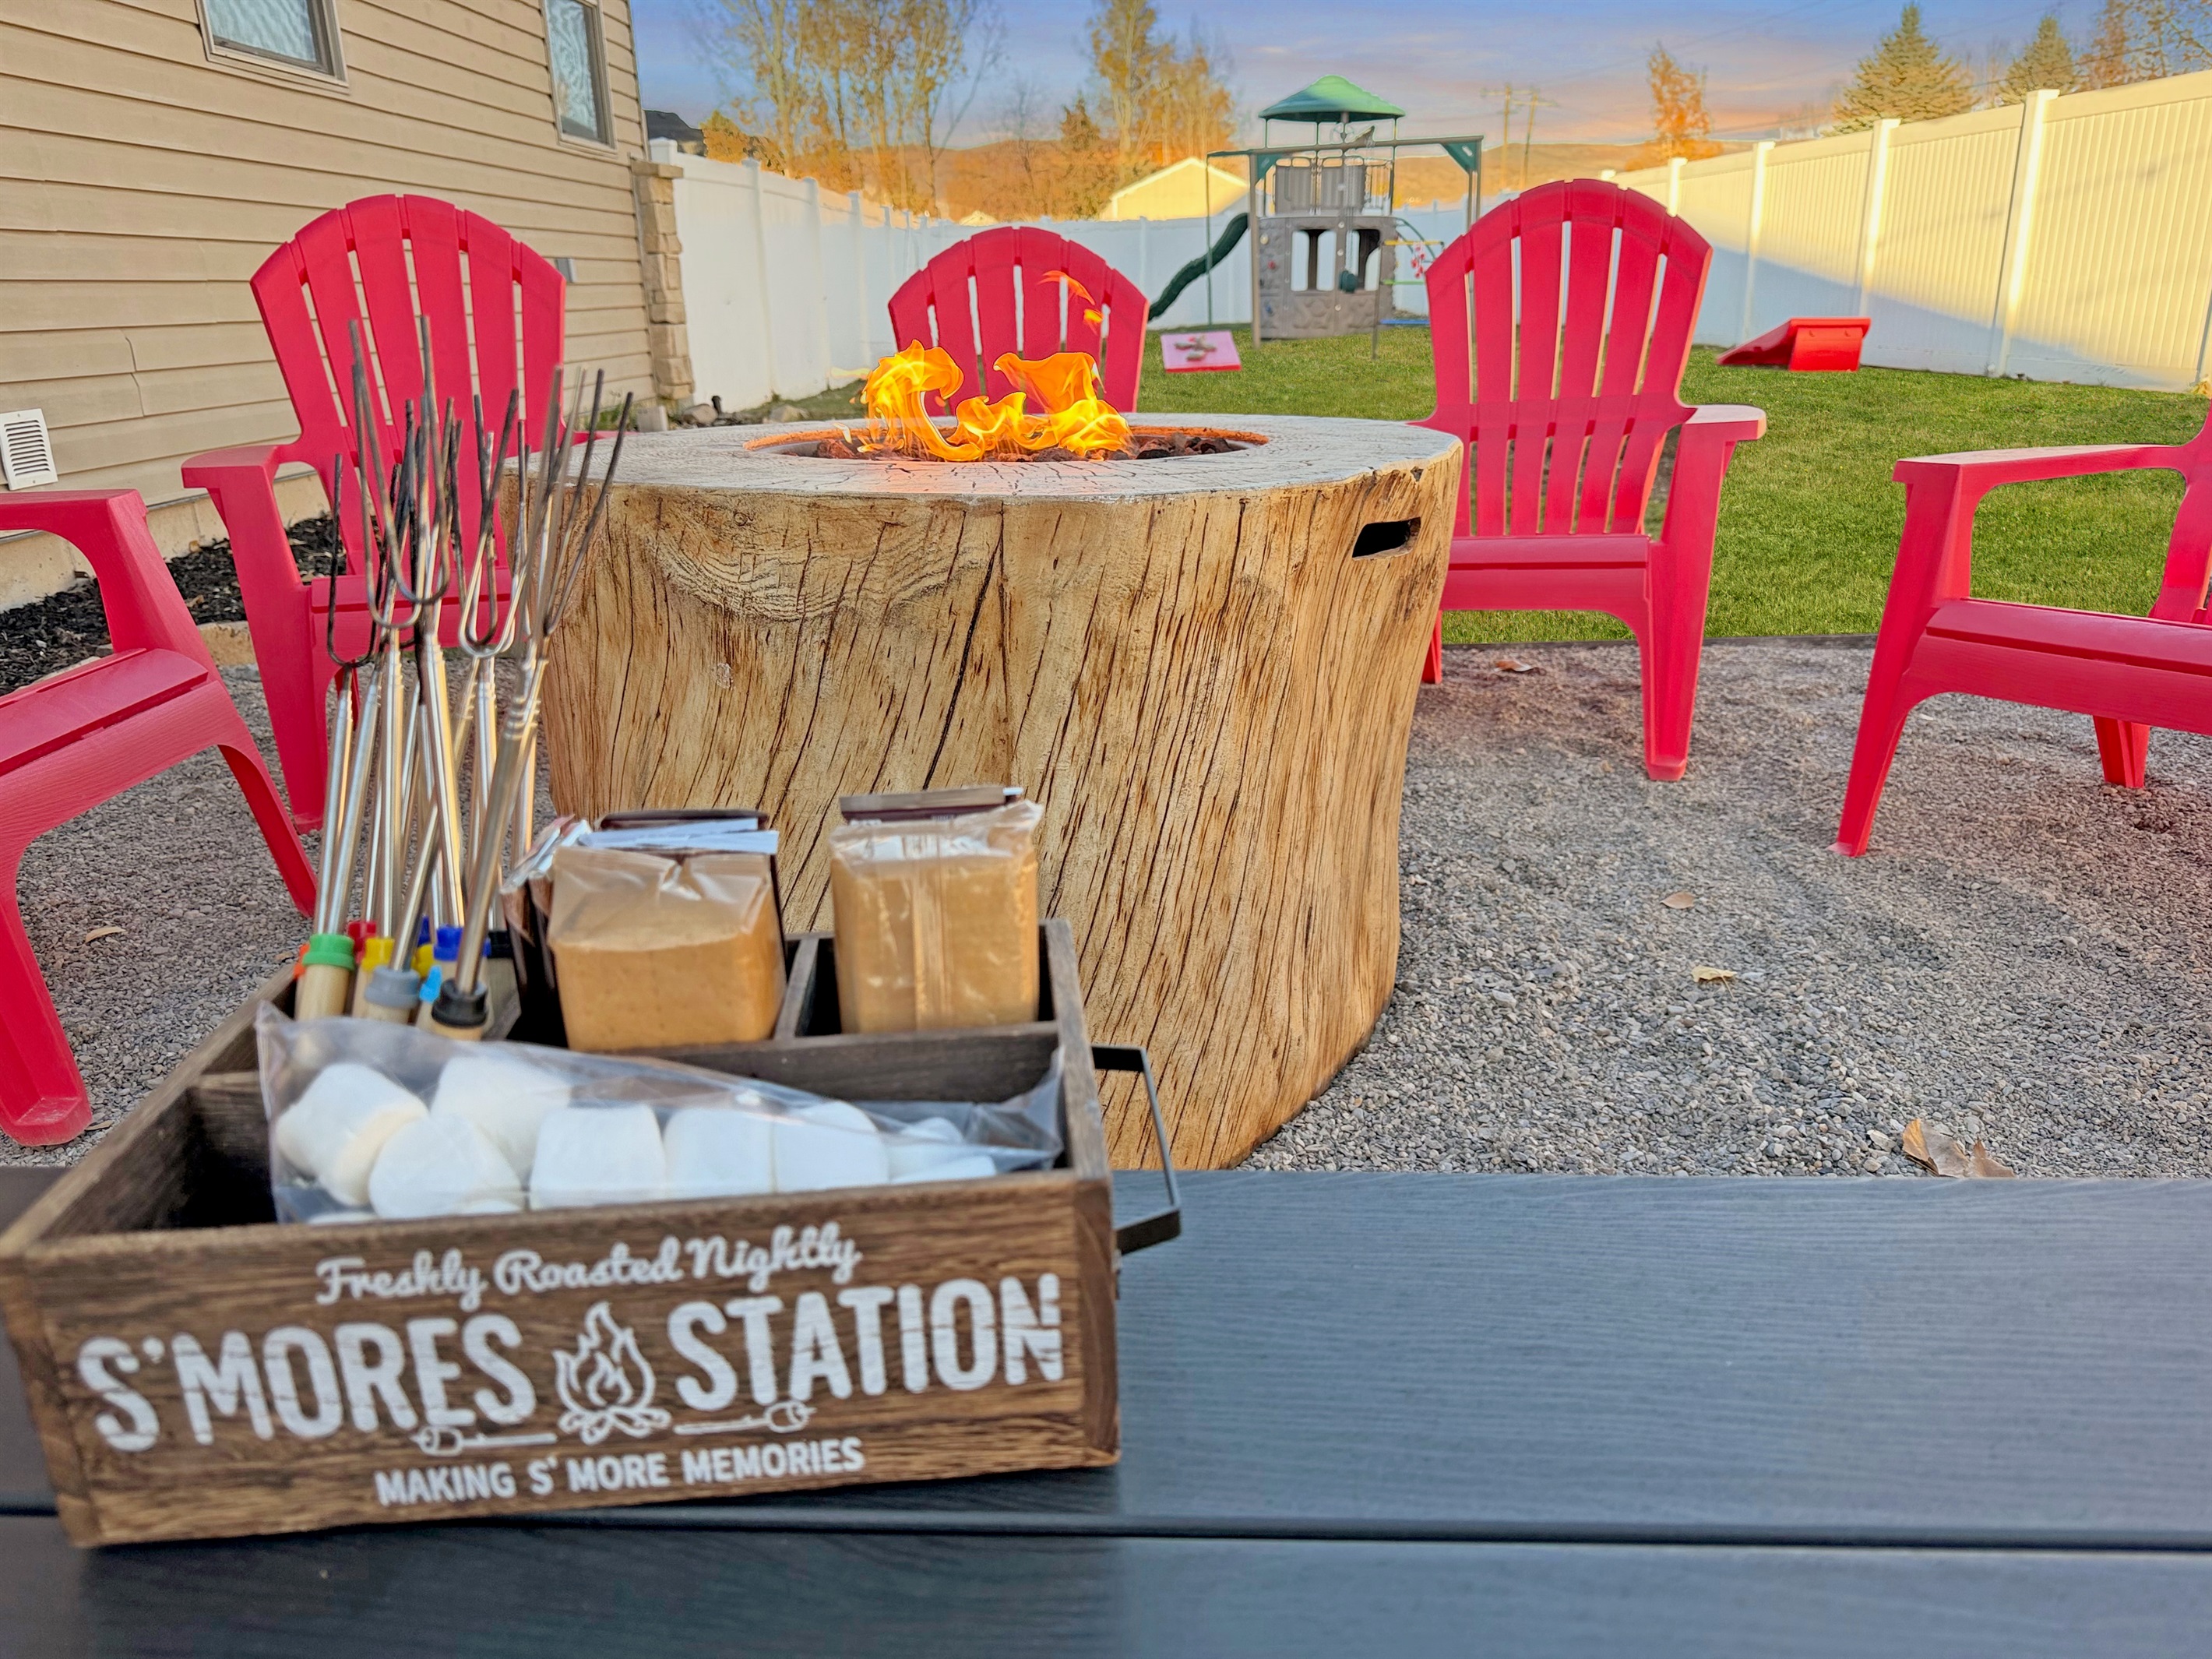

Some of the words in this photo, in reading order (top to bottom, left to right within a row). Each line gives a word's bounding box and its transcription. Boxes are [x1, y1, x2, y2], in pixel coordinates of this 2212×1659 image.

[315, 1248, 488, 1312] Freshly
[493, 1235, 684, 1294] Roasted
[685, 1221, 863, 1293] Nightly
[79, 1313, 537, 1452] S'MORES
[667, 1273, 1063, 1411] STATION
[374, 1461, 518, 1507] MAKING
[682, 1437, 865, 1484] MEMORIES
